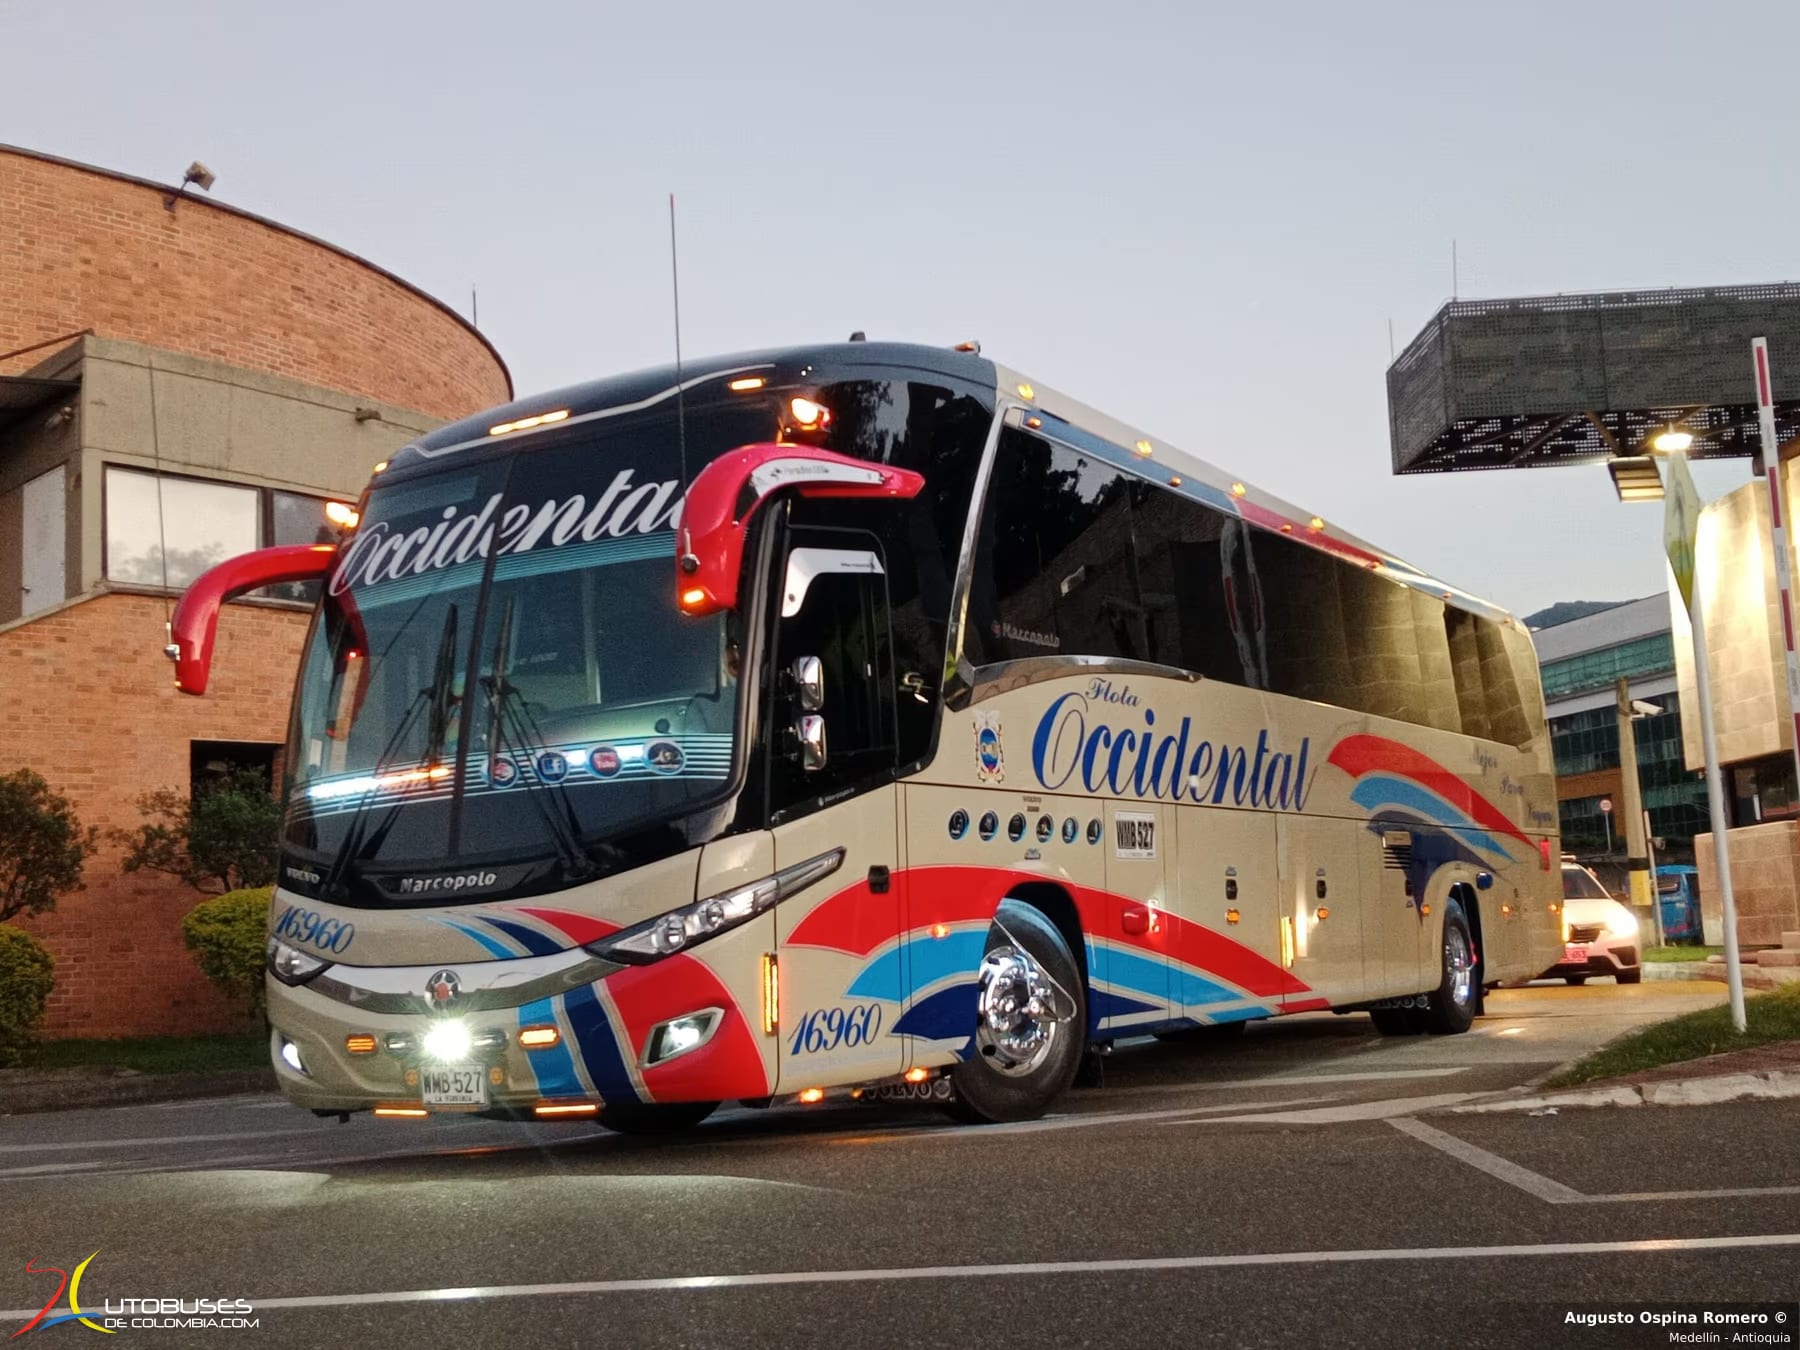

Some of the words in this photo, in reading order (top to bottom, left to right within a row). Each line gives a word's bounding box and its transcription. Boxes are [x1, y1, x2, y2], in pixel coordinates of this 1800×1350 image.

[1084, 676, 1141, 708] Flota
[1031, 691, 1318, 812] Occidental
[1115, 820, 1137, 849] WMB
[1137, 821, 1155, 850] 527
[286, 866, 321, 884] VOLVO
[399, 871, 497, 894] Marcopolo
[275, 905, 355, 955] 16960
[786, 1002, 882, 1057] 16960
[423, 1072, 450, 1094] WMB
[453, 1071, 482, 1094] 527
[865, 1082, 933, 1100] VOLVO
